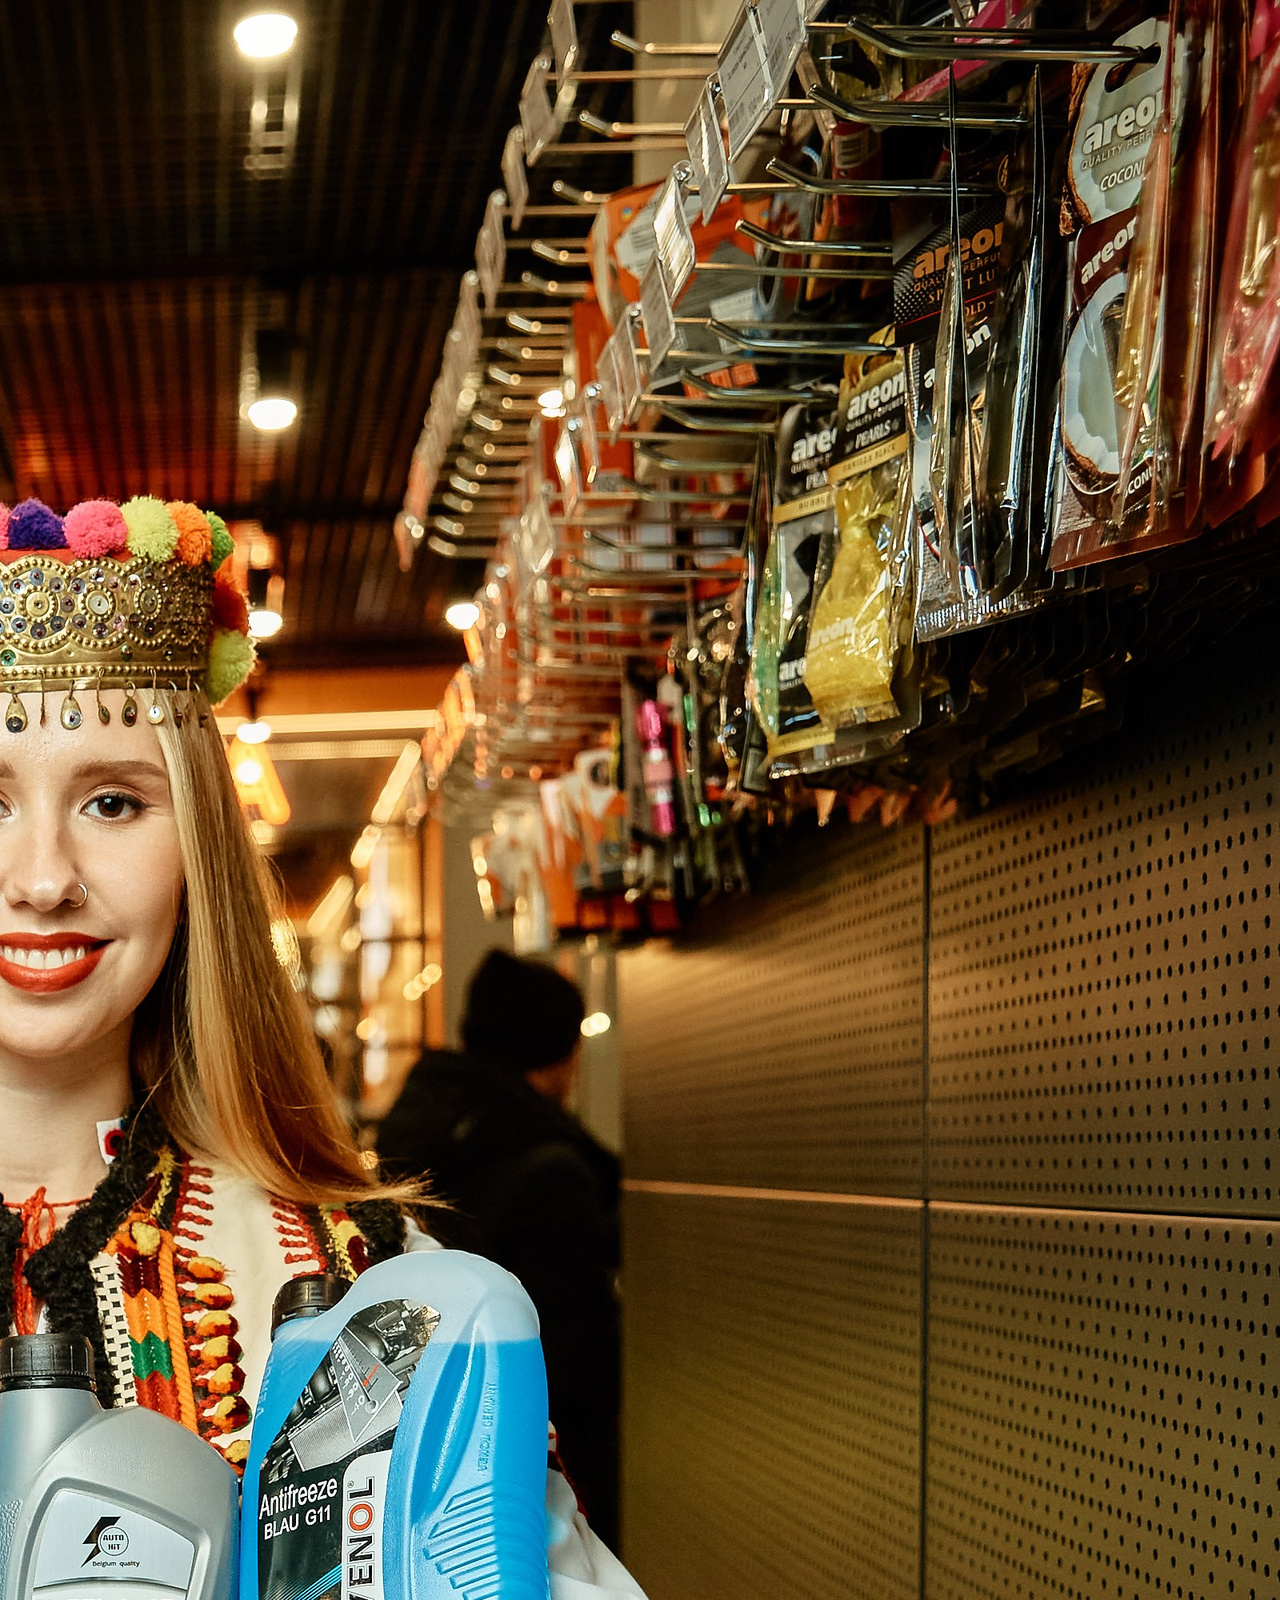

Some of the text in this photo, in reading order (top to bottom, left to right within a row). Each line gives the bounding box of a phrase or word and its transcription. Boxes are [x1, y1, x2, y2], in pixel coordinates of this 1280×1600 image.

[847, 371, 904, 421] areon
[855, 419, 891, 450] PEARLS
[258, 1476, 337, 1520] Antifreeze
[263, 1504, 331, 1540] BLAU G11
[92, 1560, 140, 1568] Belgium quality
